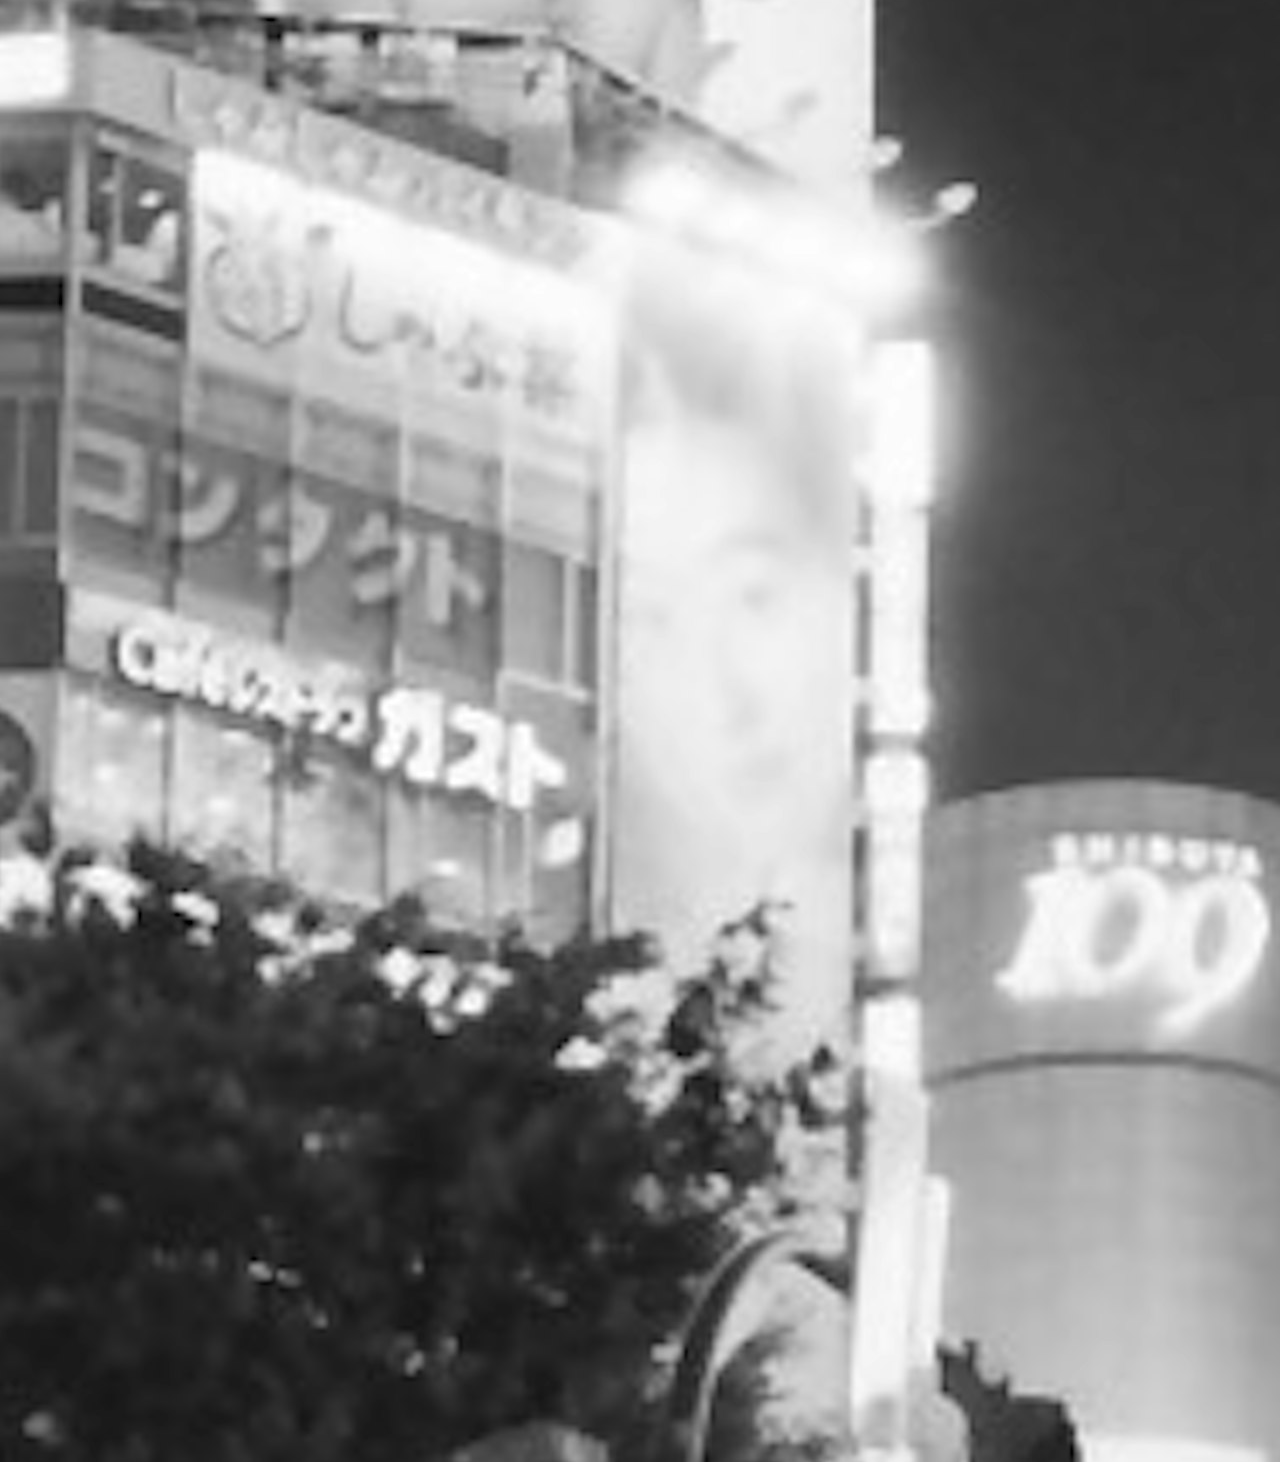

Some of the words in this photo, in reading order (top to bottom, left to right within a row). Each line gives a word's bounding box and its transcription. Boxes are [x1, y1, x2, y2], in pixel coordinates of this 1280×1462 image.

[72, 428, 485, 628] コンタクト
[994, 864, 1271, 1041] 109
